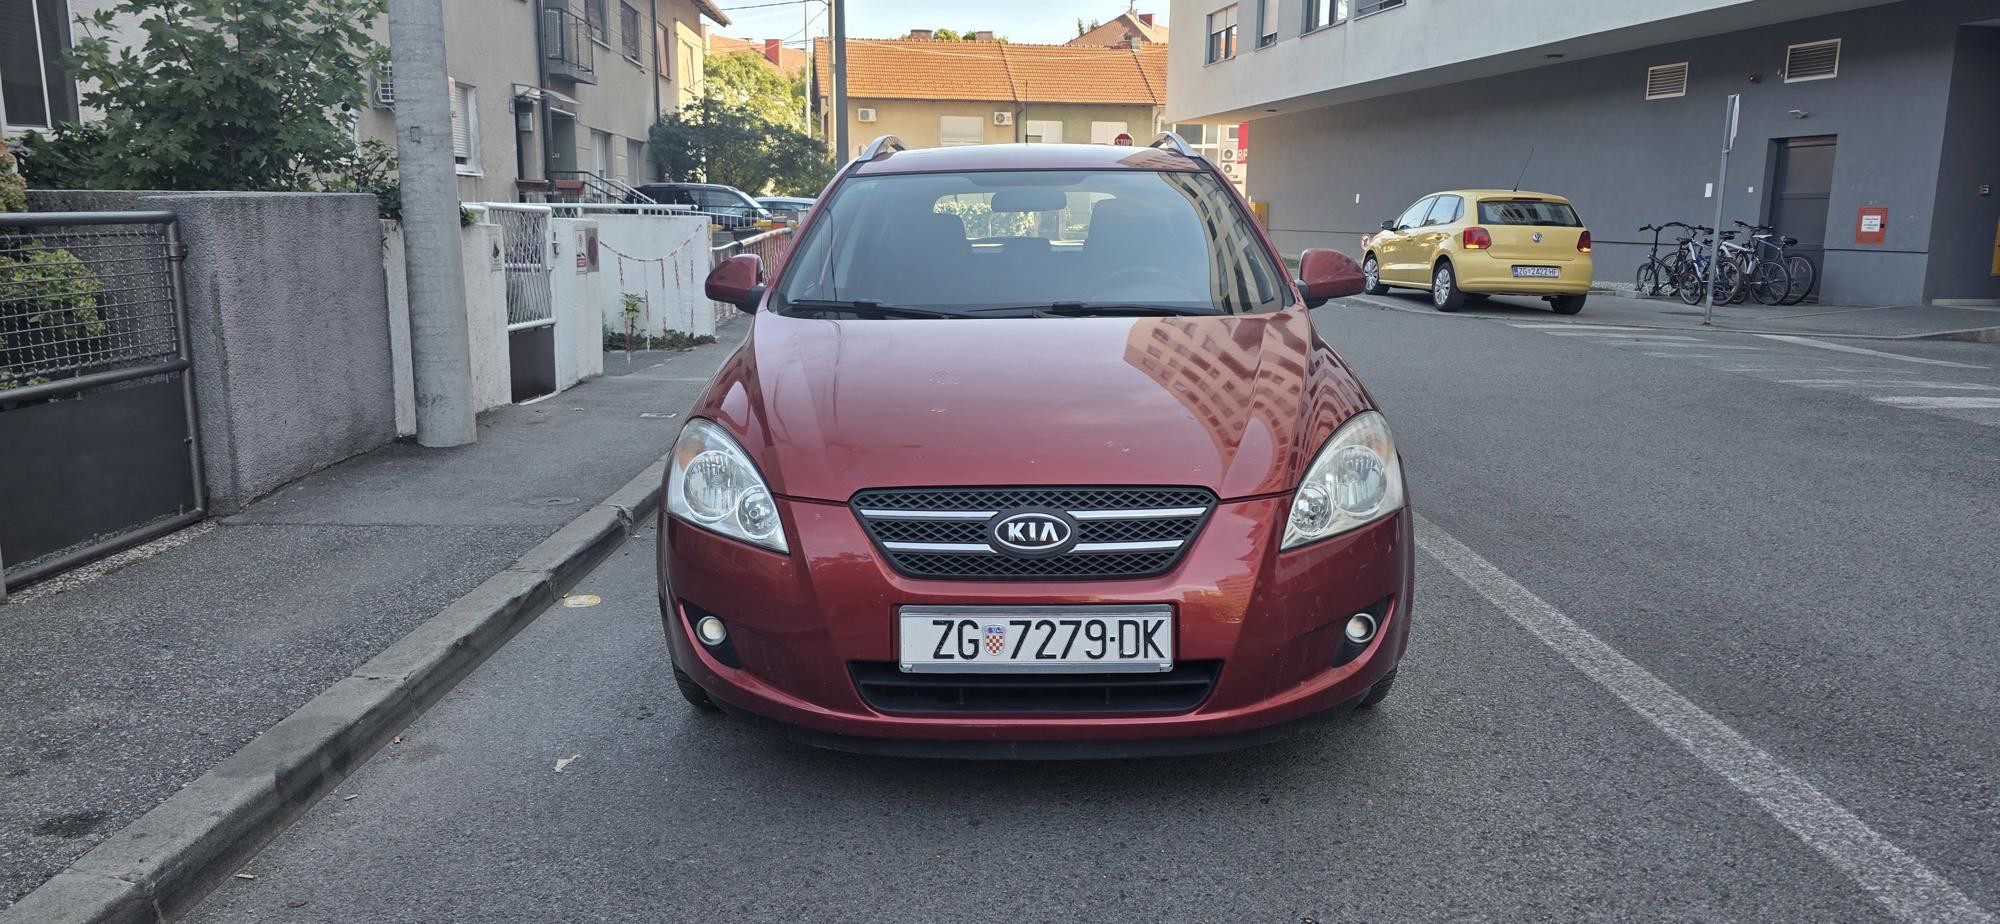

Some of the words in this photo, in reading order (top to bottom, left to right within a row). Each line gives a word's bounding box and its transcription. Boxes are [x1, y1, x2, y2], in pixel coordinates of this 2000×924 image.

[1518, 267, 1527, 275] ZG
[1007, 522, 1059, 542] KIA
[932, 619, 980, 660] ZG
